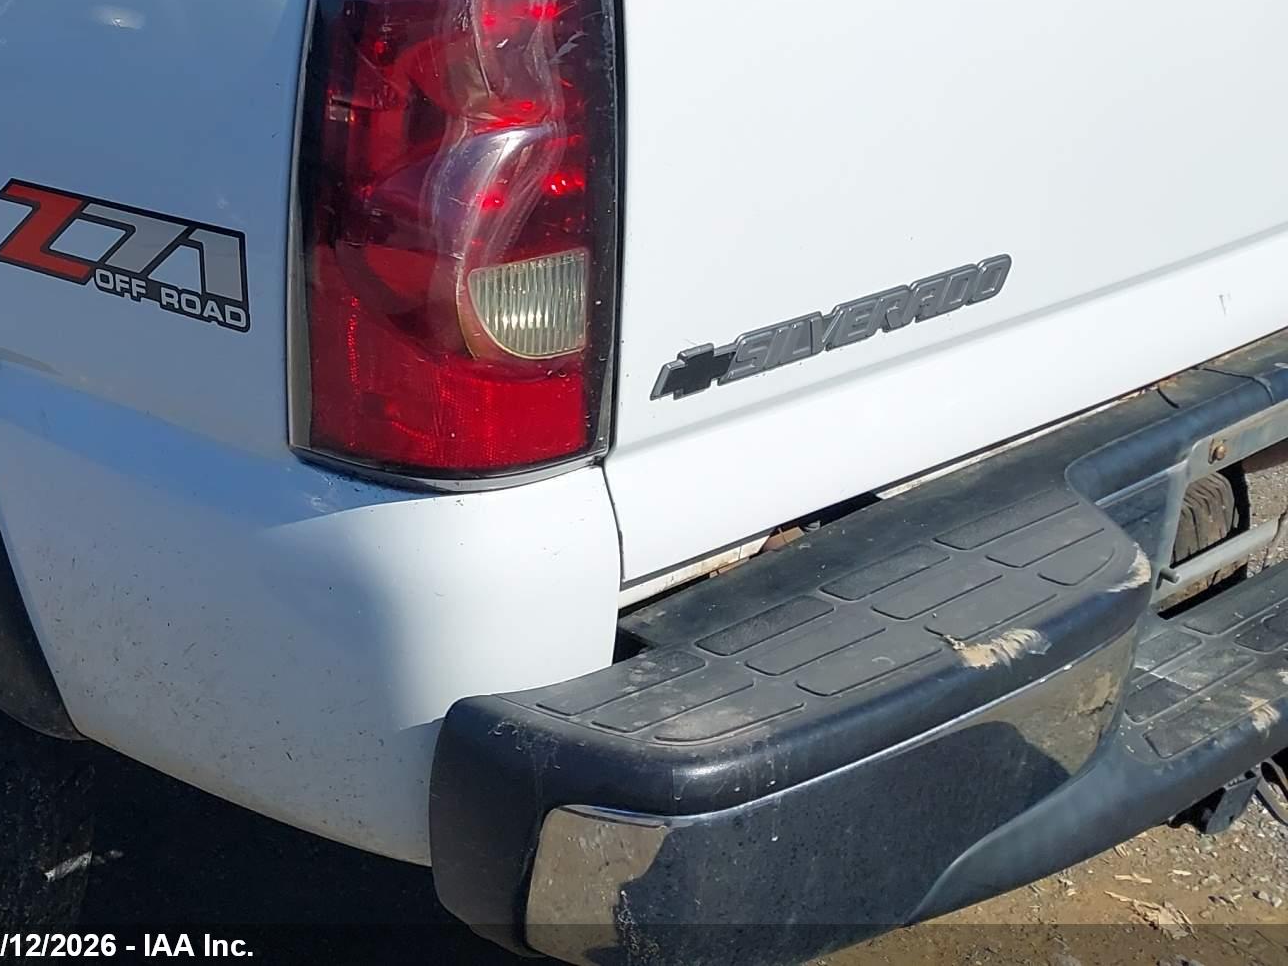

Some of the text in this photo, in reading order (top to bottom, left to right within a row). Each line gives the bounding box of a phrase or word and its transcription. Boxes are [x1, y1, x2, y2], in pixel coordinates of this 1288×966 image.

[94, 268, 248, 329] OFF ROAD
[717, 253, 1012, 386] SILVERADO
